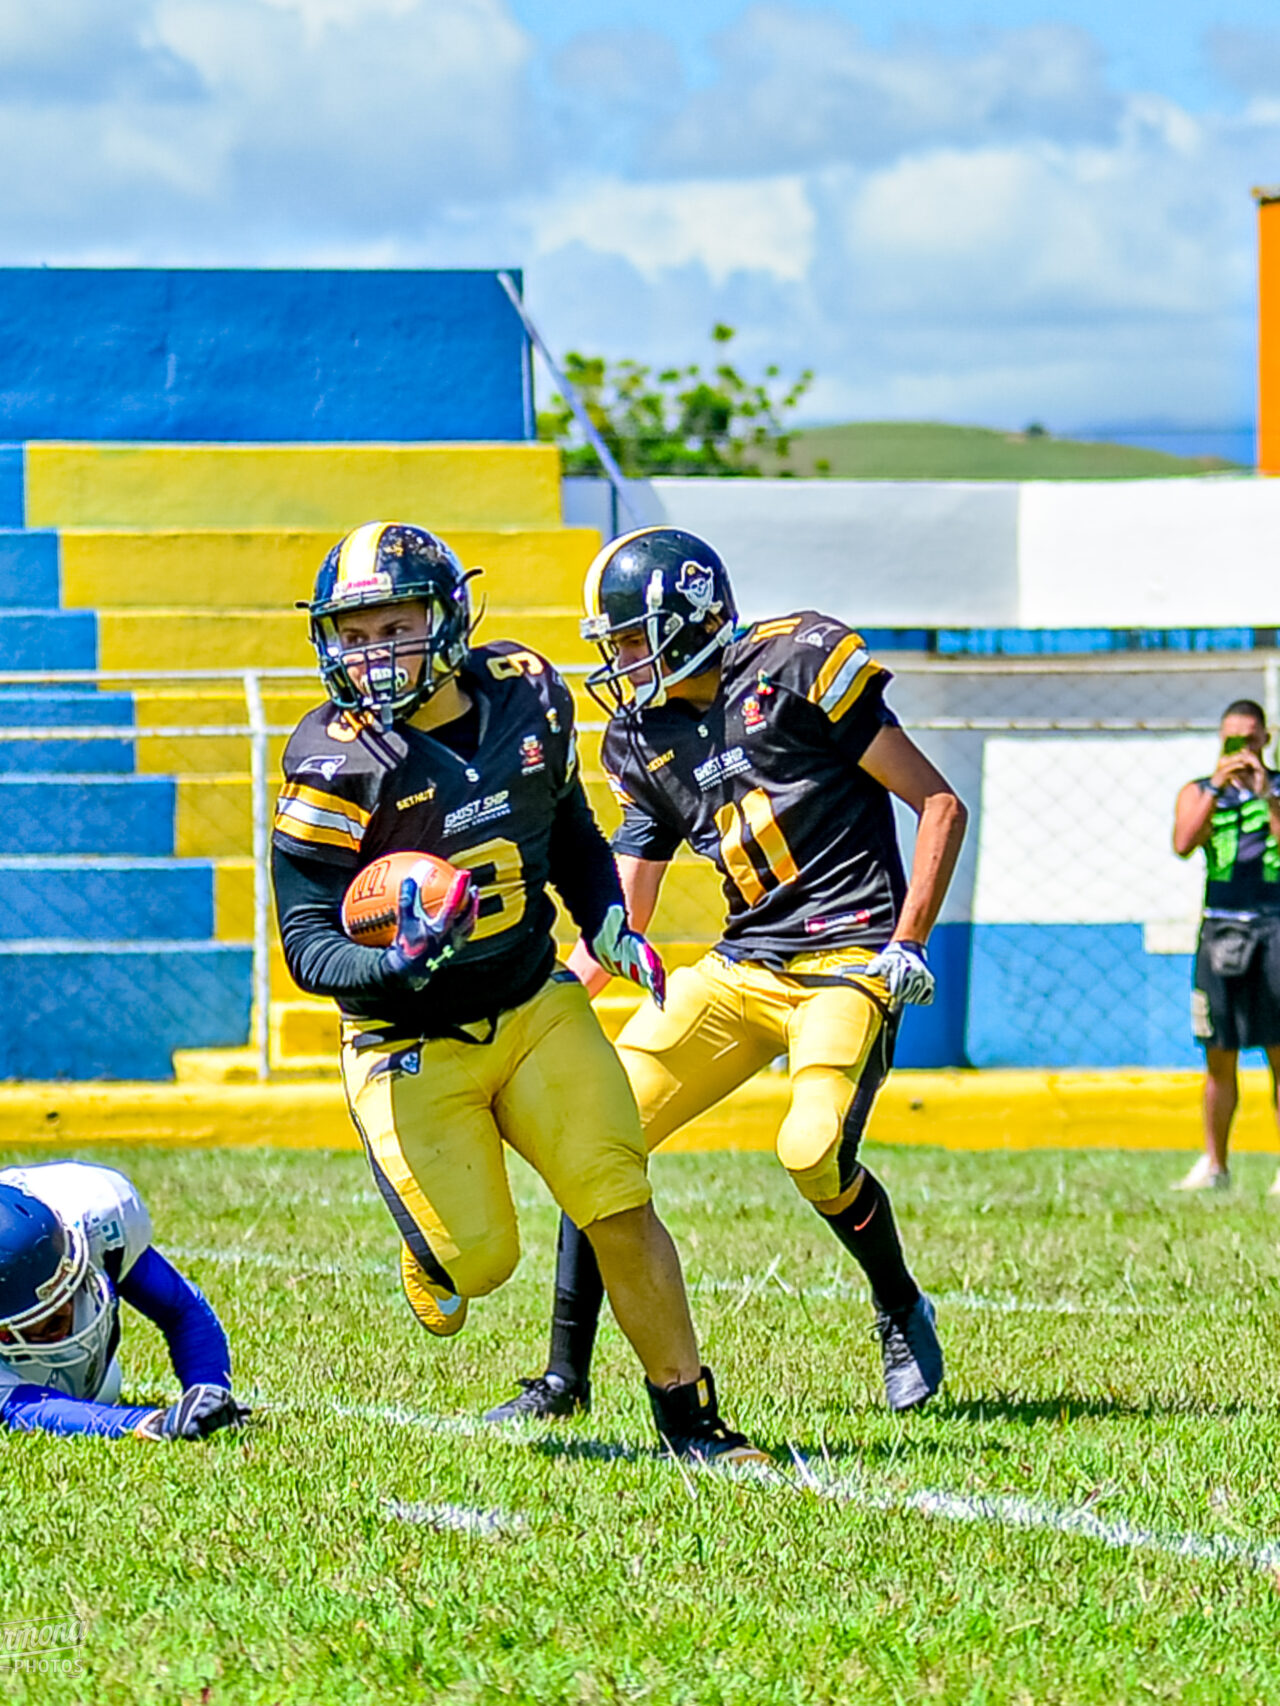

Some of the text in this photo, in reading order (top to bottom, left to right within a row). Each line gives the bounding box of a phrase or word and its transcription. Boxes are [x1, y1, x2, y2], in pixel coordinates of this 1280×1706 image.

[693, 756, 722, 782] GHOST
[720, 746, 744, 767] SHIP
[444, 799, 482, 828] GHOST
[482, 790, 509, 809] SHIP
[713, 787, 799, 907] 11
